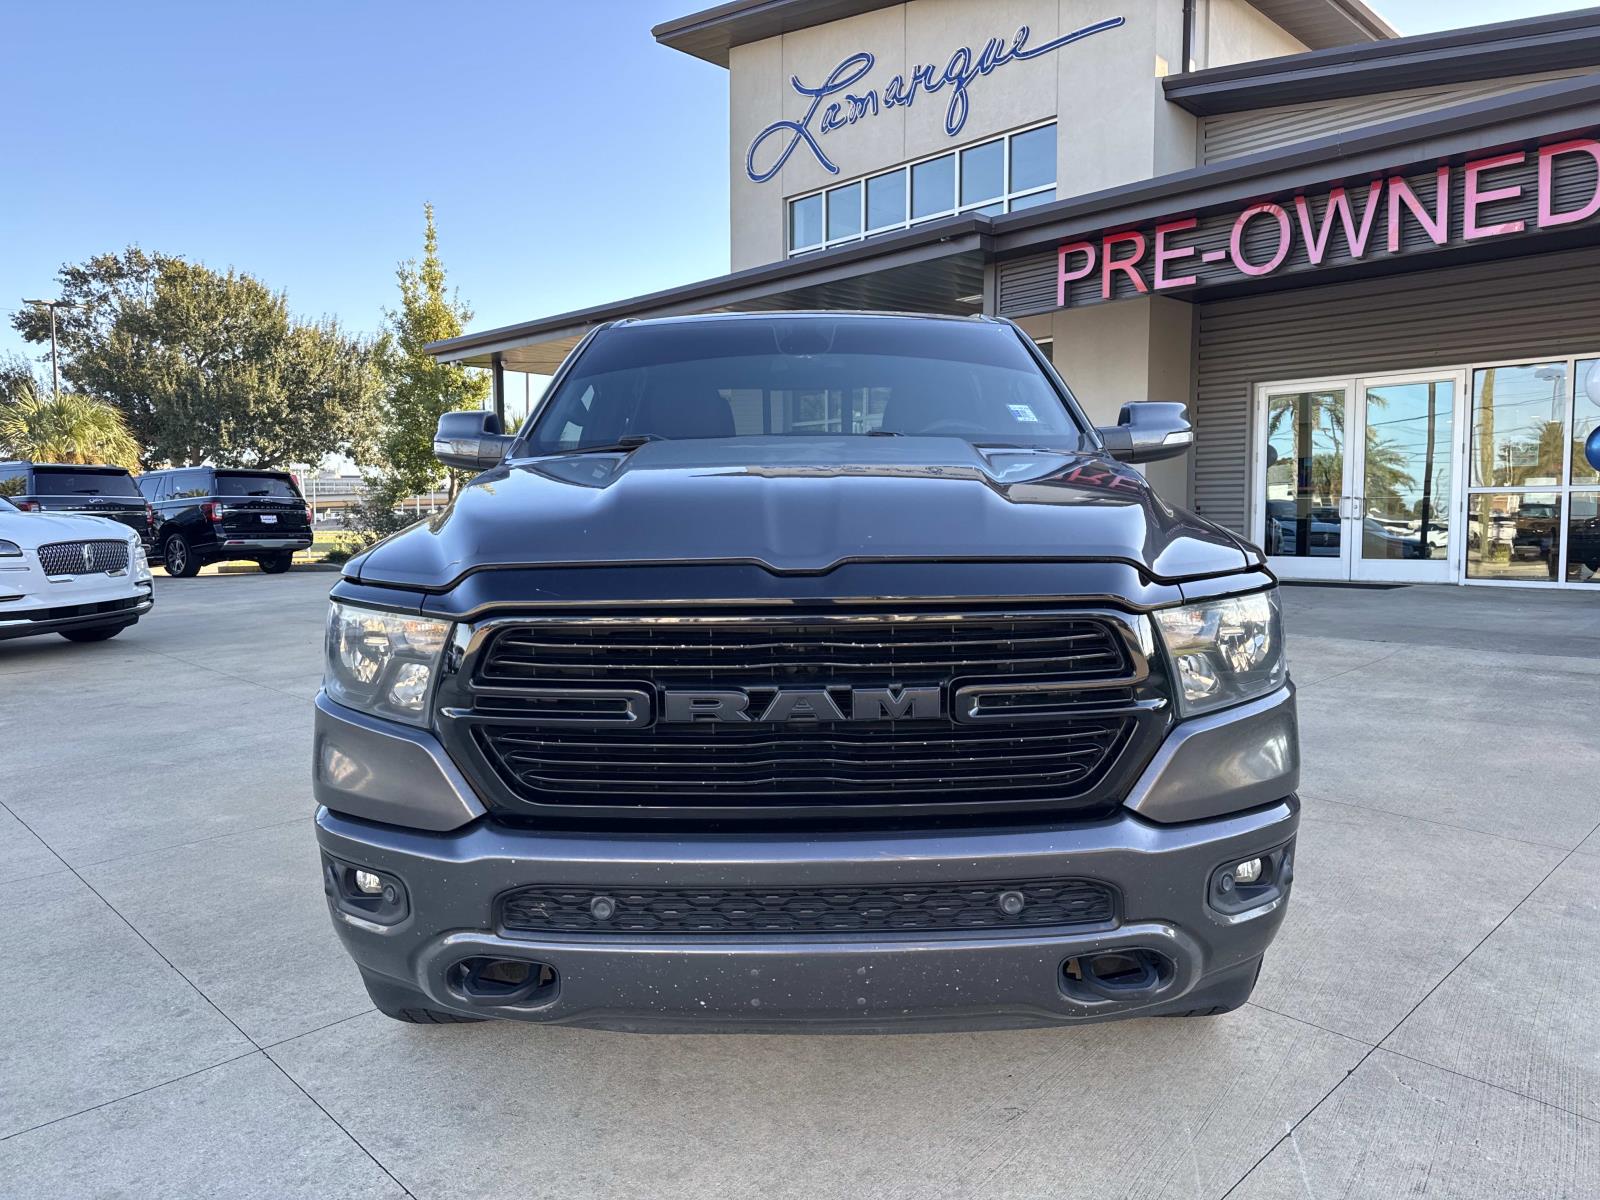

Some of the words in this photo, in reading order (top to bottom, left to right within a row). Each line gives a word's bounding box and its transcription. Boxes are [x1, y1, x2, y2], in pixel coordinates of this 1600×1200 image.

[746, 16, 1125, 183] Lamarque
[1056, 139, 1600, 306] PRE-OWNED
[664, 687, 941, 721] RAM
